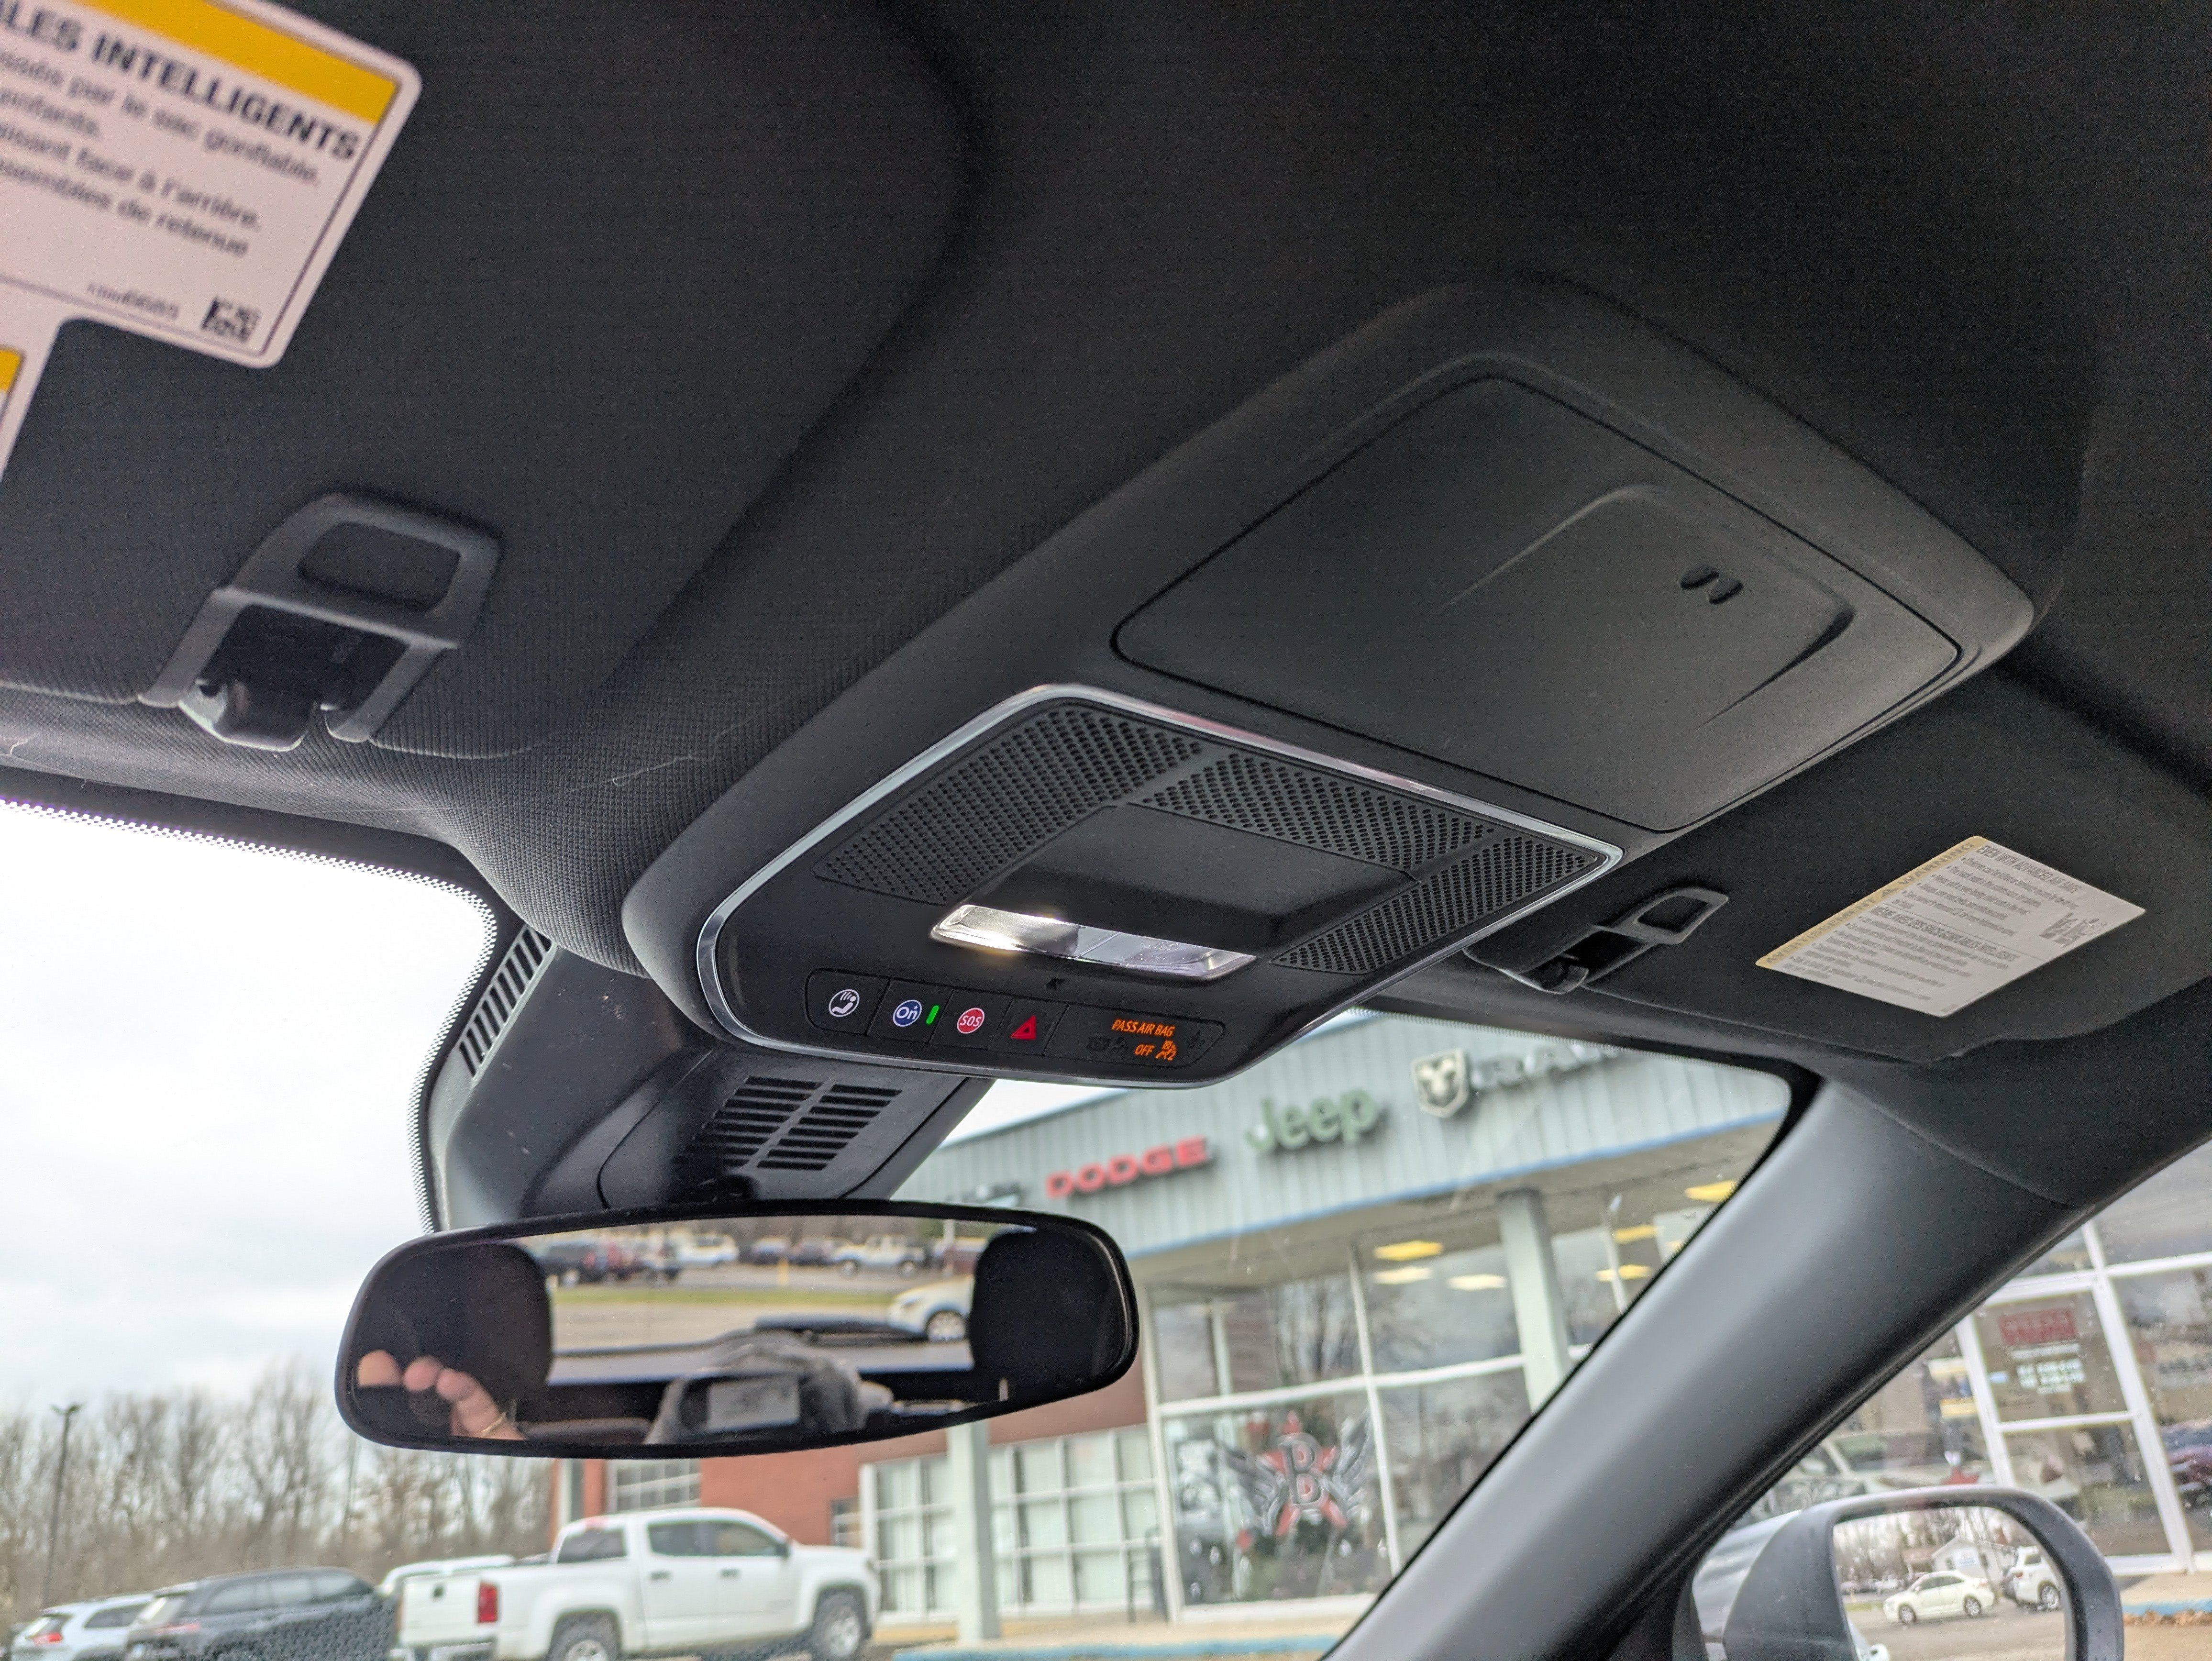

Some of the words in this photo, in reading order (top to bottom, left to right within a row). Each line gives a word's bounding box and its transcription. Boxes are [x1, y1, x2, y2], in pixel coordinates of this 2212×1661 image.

[0, 0, 84, 52] LES
[91, 32, 362, 162] INTELLIGENTS
[1896, 842, 1974, 886] WARNING
[1974, 844, 2002, 859] EVEN
[1993, 853, 2020, 866] WITH
[2011, 860, 2055, 881] ADVANCED
[2045, 875, 2067, 886] AIR
[896, 1006, 918, 1020] On
[960, 1015, 982, 1027] SOS
[1111, 1019, 1139, 1032] PASS
[1136, 1023, 1155, 1035] AIR
[1154, 1024, 1175, 1037] BAG
[1134, 1044, 1155, 1056] OFF
[1244, 1088, 1374, 1153] Jeep
[1046, 1135, 1208, 1199] DODGE
